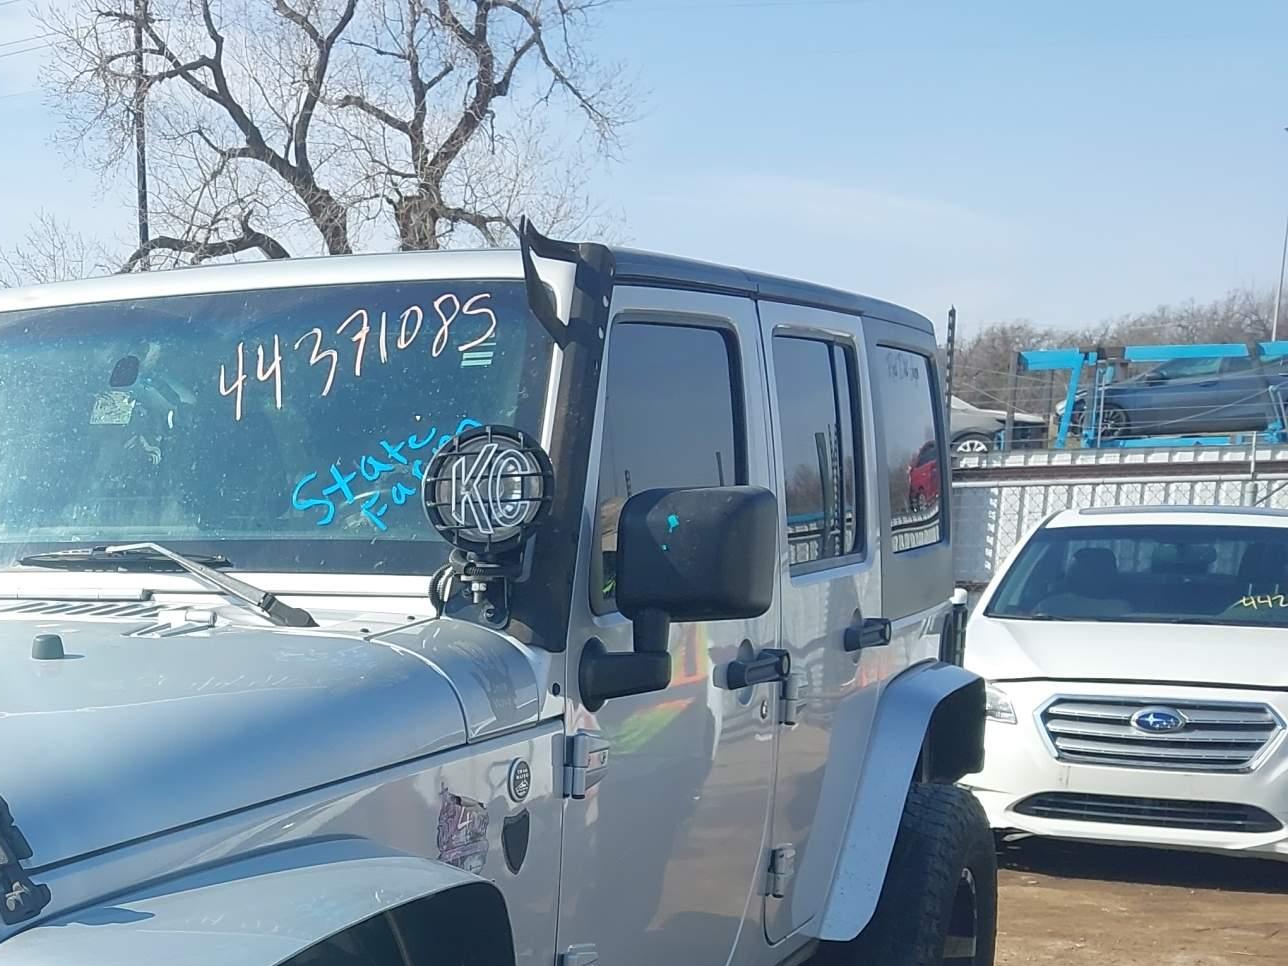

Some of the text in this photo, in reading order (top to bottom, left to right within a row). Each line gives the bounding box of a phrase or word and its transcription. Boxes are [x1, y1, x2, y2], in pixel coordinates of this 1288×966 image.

[218, 293, 497, 422] 44371085
[292, 427, 437, 526] State
[451, 443, 529, 535] KC
